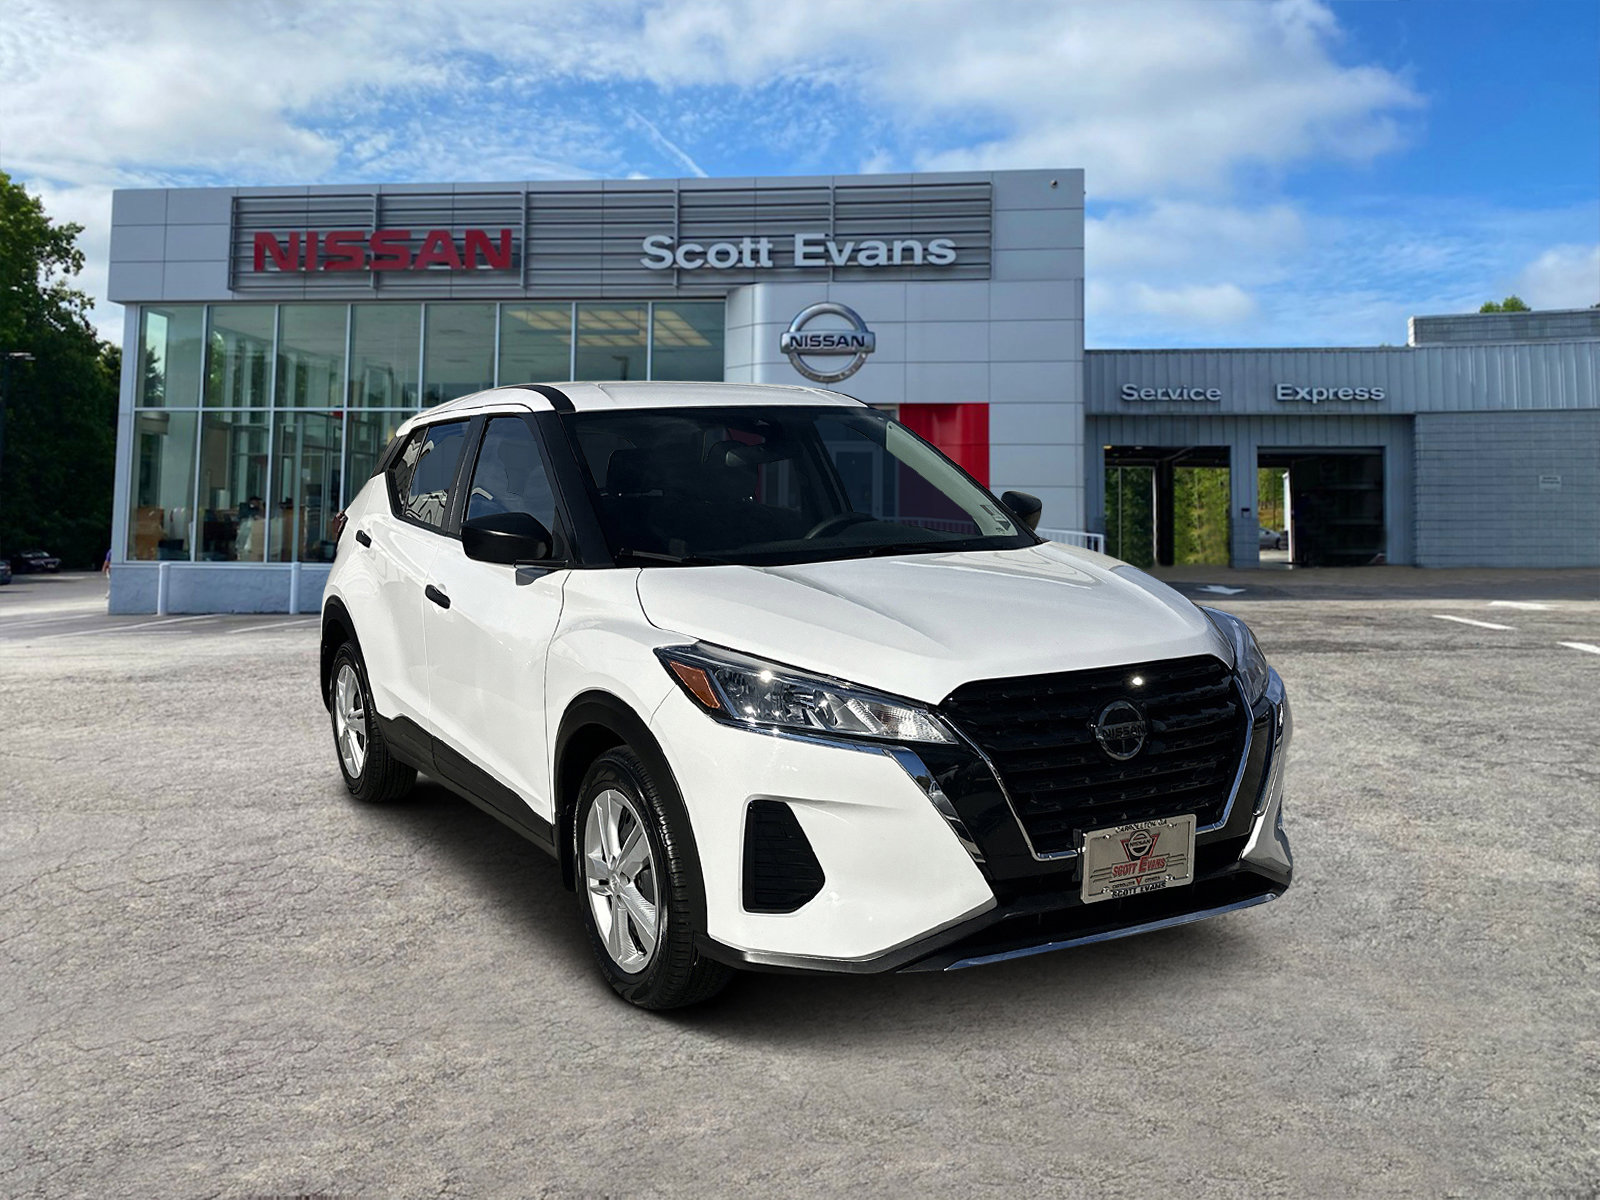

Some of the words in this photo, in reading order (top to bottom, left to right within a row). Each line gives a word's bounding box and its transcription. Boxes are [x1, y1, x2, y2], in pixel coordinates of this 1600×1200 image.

[254, 228, 513, 272] NISSAN
[640, 234, 774, 270] Scott
[793, 232, 957, 267] Evans
[789, 335, 866, 348] NISSAN
[1120, 383, 1222, 402] Service
[1275, 383, 1387, 404] Express
[1112, 863, 1137, 878] SCOTT
[1138, 855, 1166, 874] EVANS
